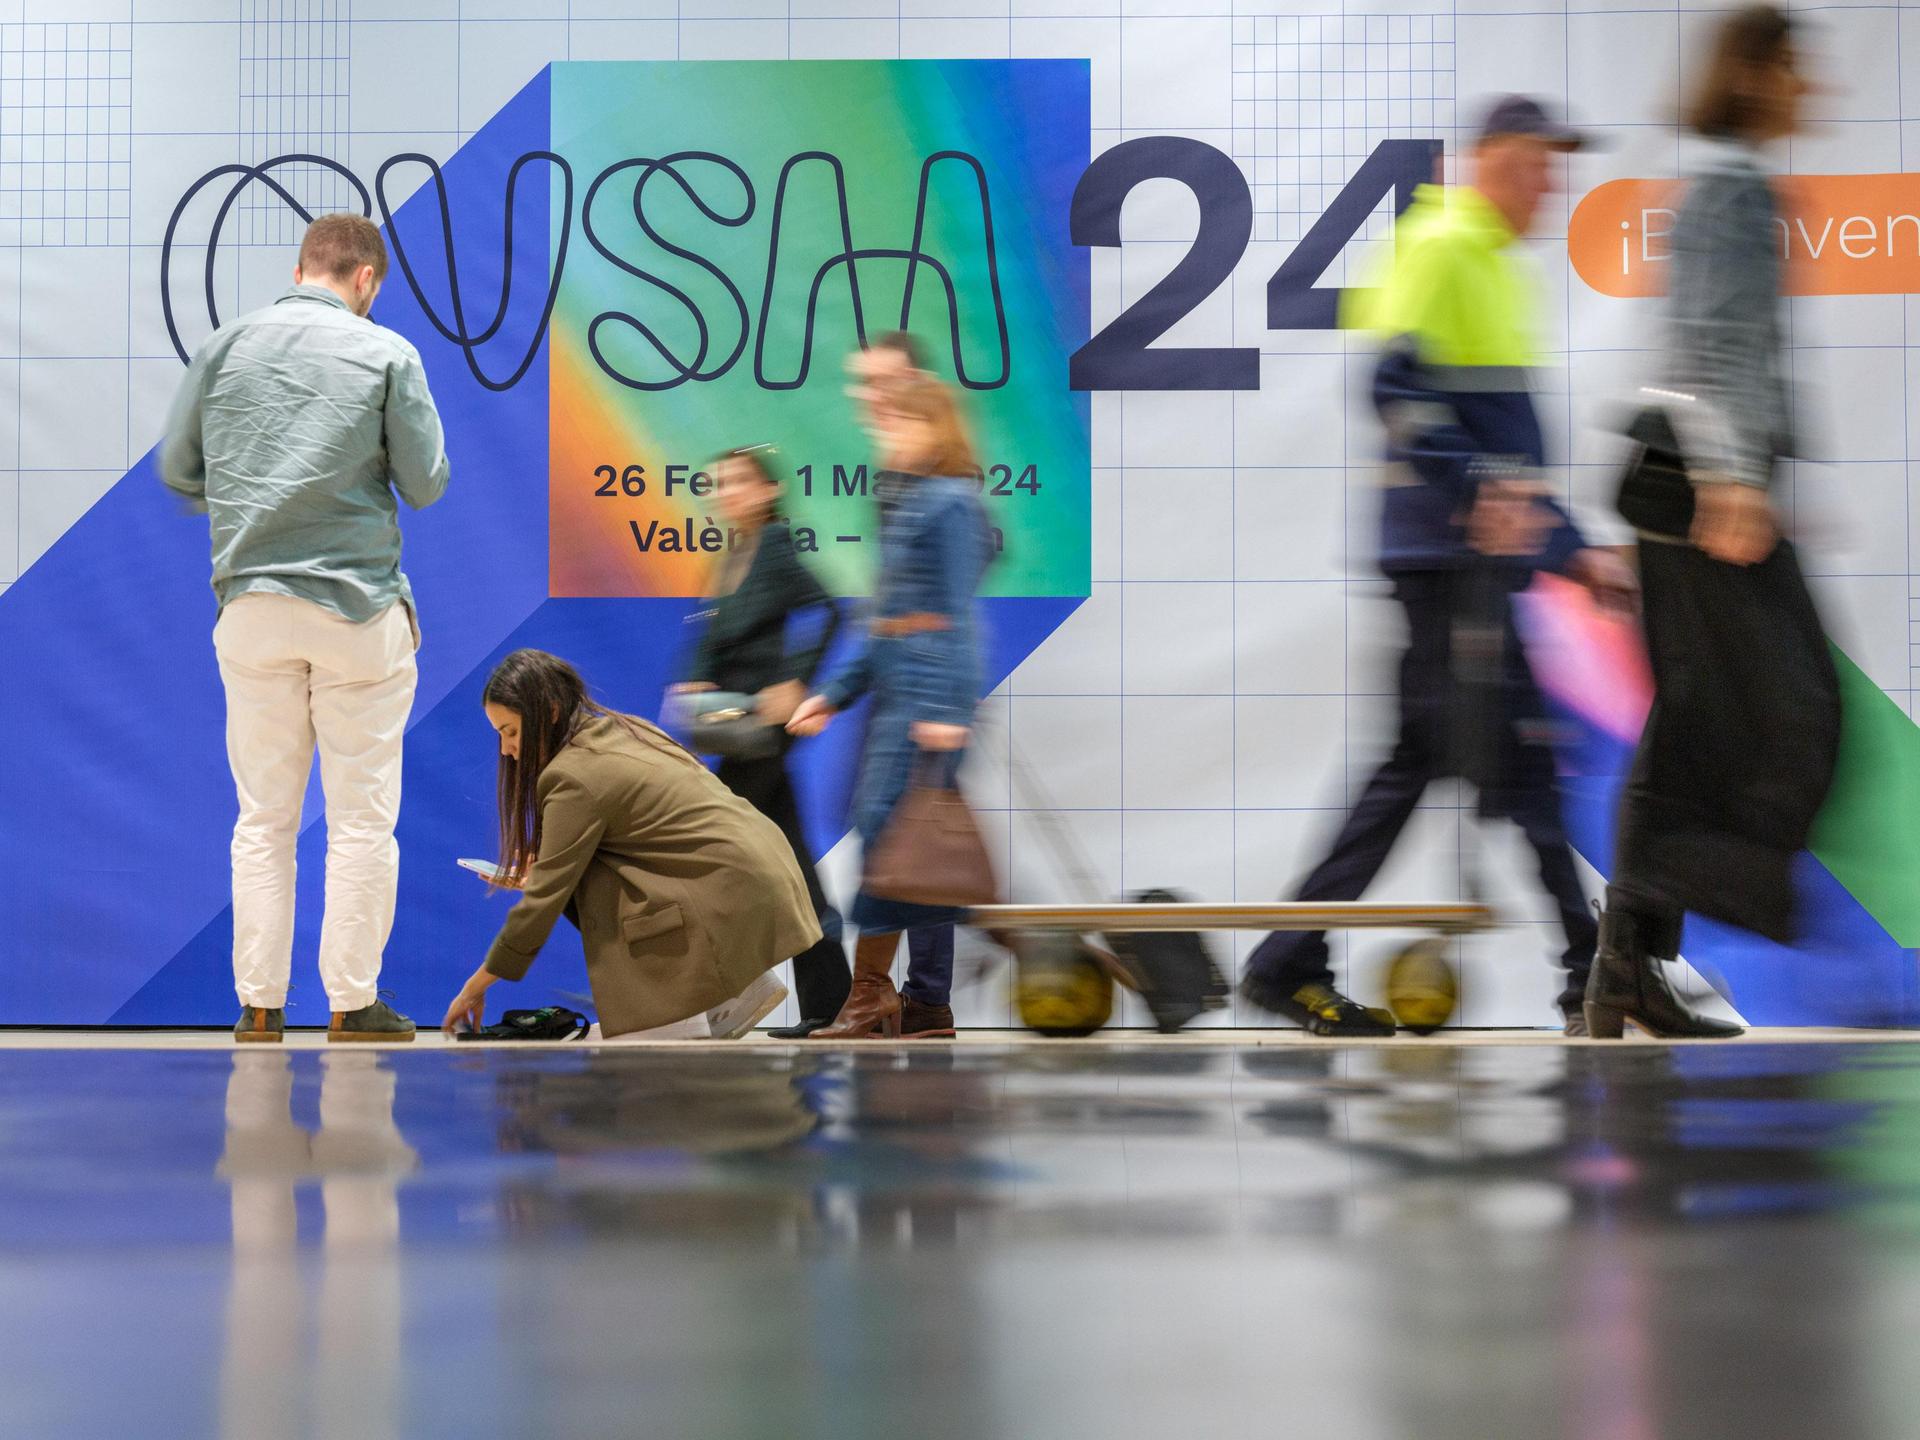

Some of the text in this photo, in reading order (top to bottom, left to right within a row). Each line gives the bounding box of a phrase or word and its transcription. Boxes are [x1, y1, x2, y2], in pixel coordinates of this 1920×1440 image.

[1069, 136, 1444, 391] 24
[1620, 207, 1920, 275] ¡Bnven
[593, 464, 646, 497] 26
[796, 464, 813, 497] 1
[832, 464, 898, 497] Ma
[958, 463, 1042, 496] 024
[629, 516, 819, 553] Valènia
